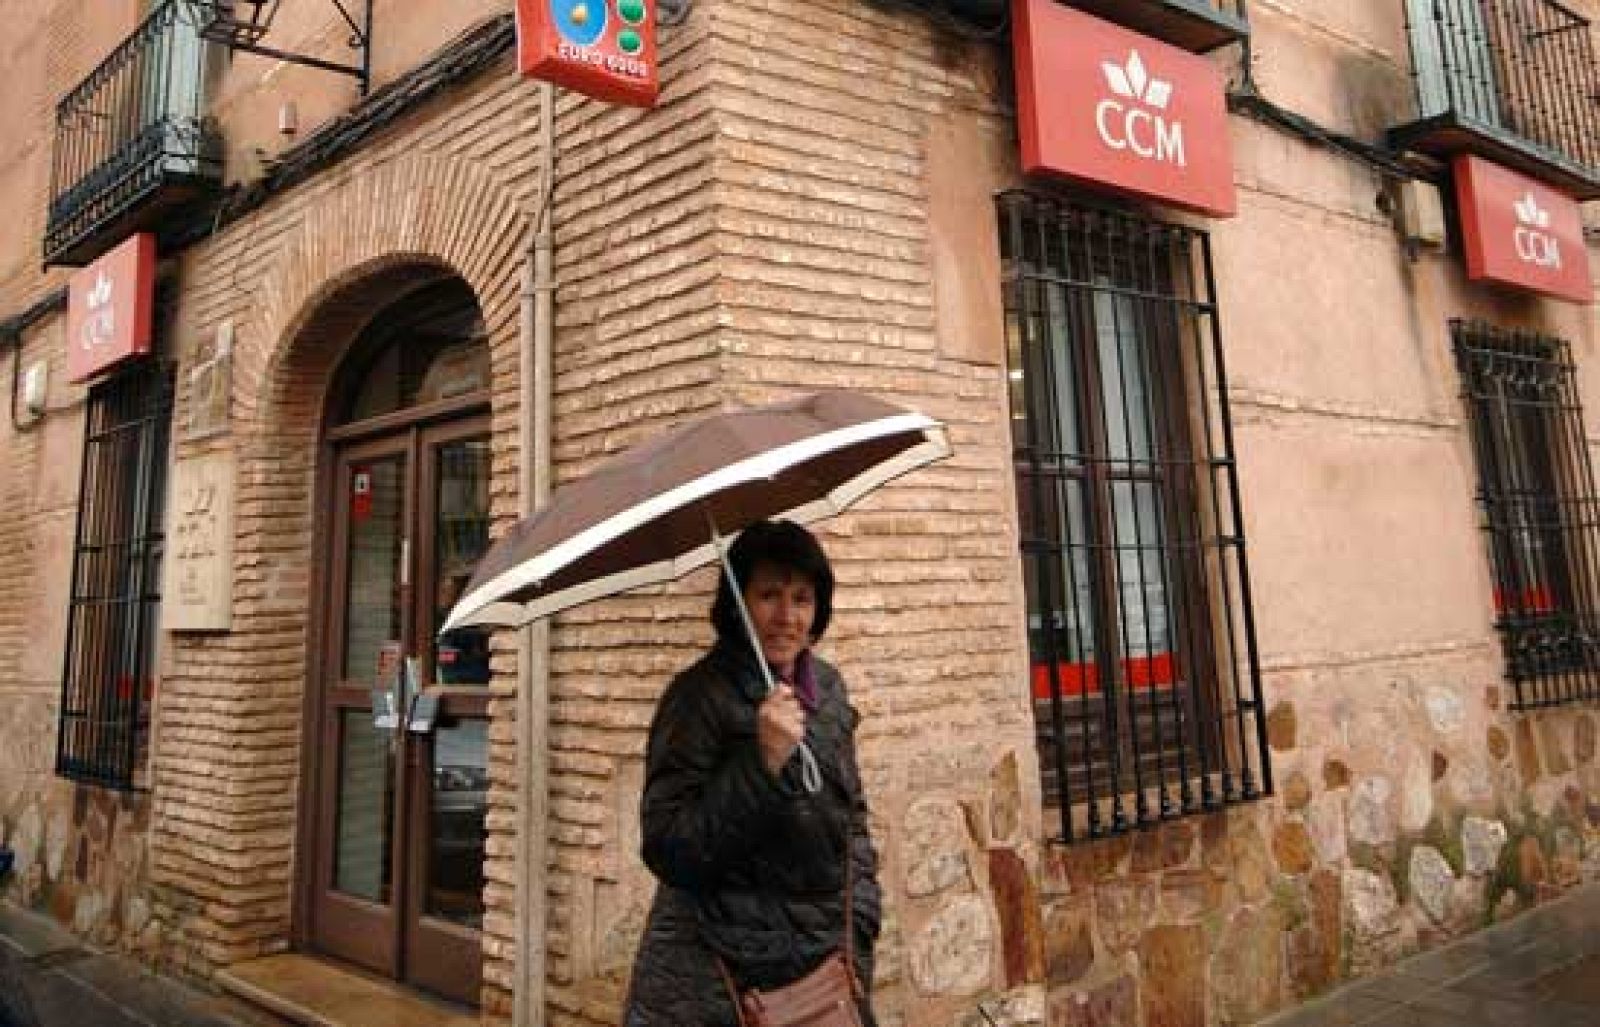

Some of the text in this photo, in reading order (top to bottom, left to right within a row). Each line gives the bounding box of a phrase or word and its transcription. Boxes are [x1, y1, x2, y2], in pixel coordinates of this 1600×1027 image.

[557, 43, 603, 64] EURO
[1096, 99, 1186, 167] CCM
[1513, 226, 1561, 270] CCM
